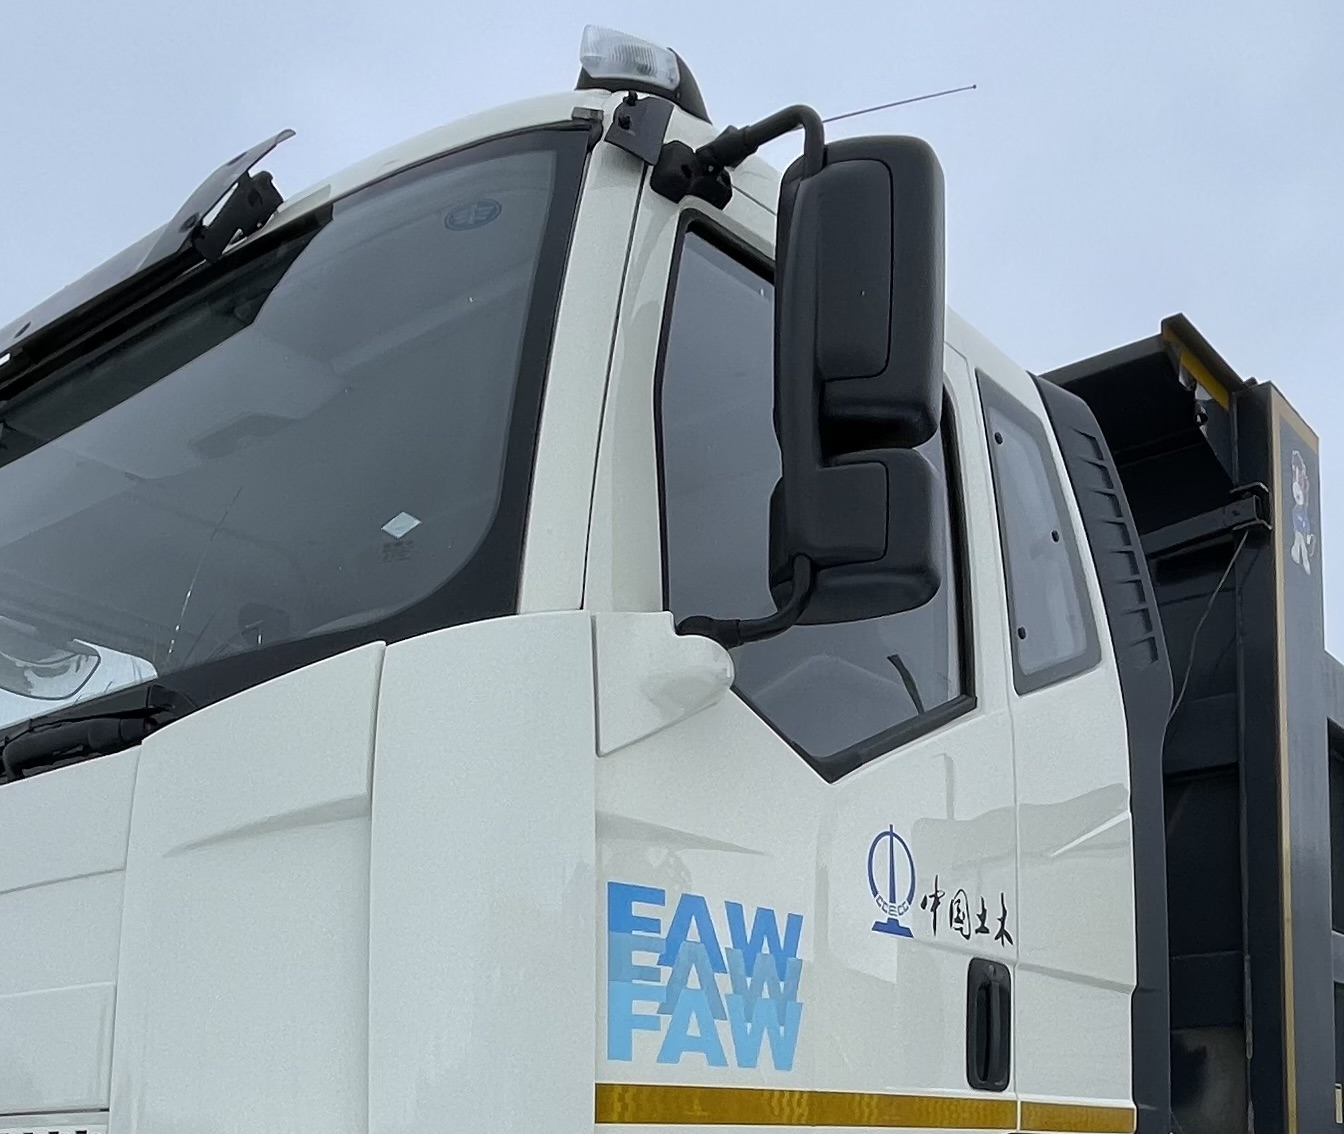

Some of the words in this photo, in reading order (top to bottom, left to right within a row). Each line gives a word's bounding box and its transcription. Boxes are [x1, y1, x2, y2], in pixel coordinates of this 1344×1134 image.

[920, 874, 1014, 948] 中国土木
[607, 980, 804, 1073] FAW
